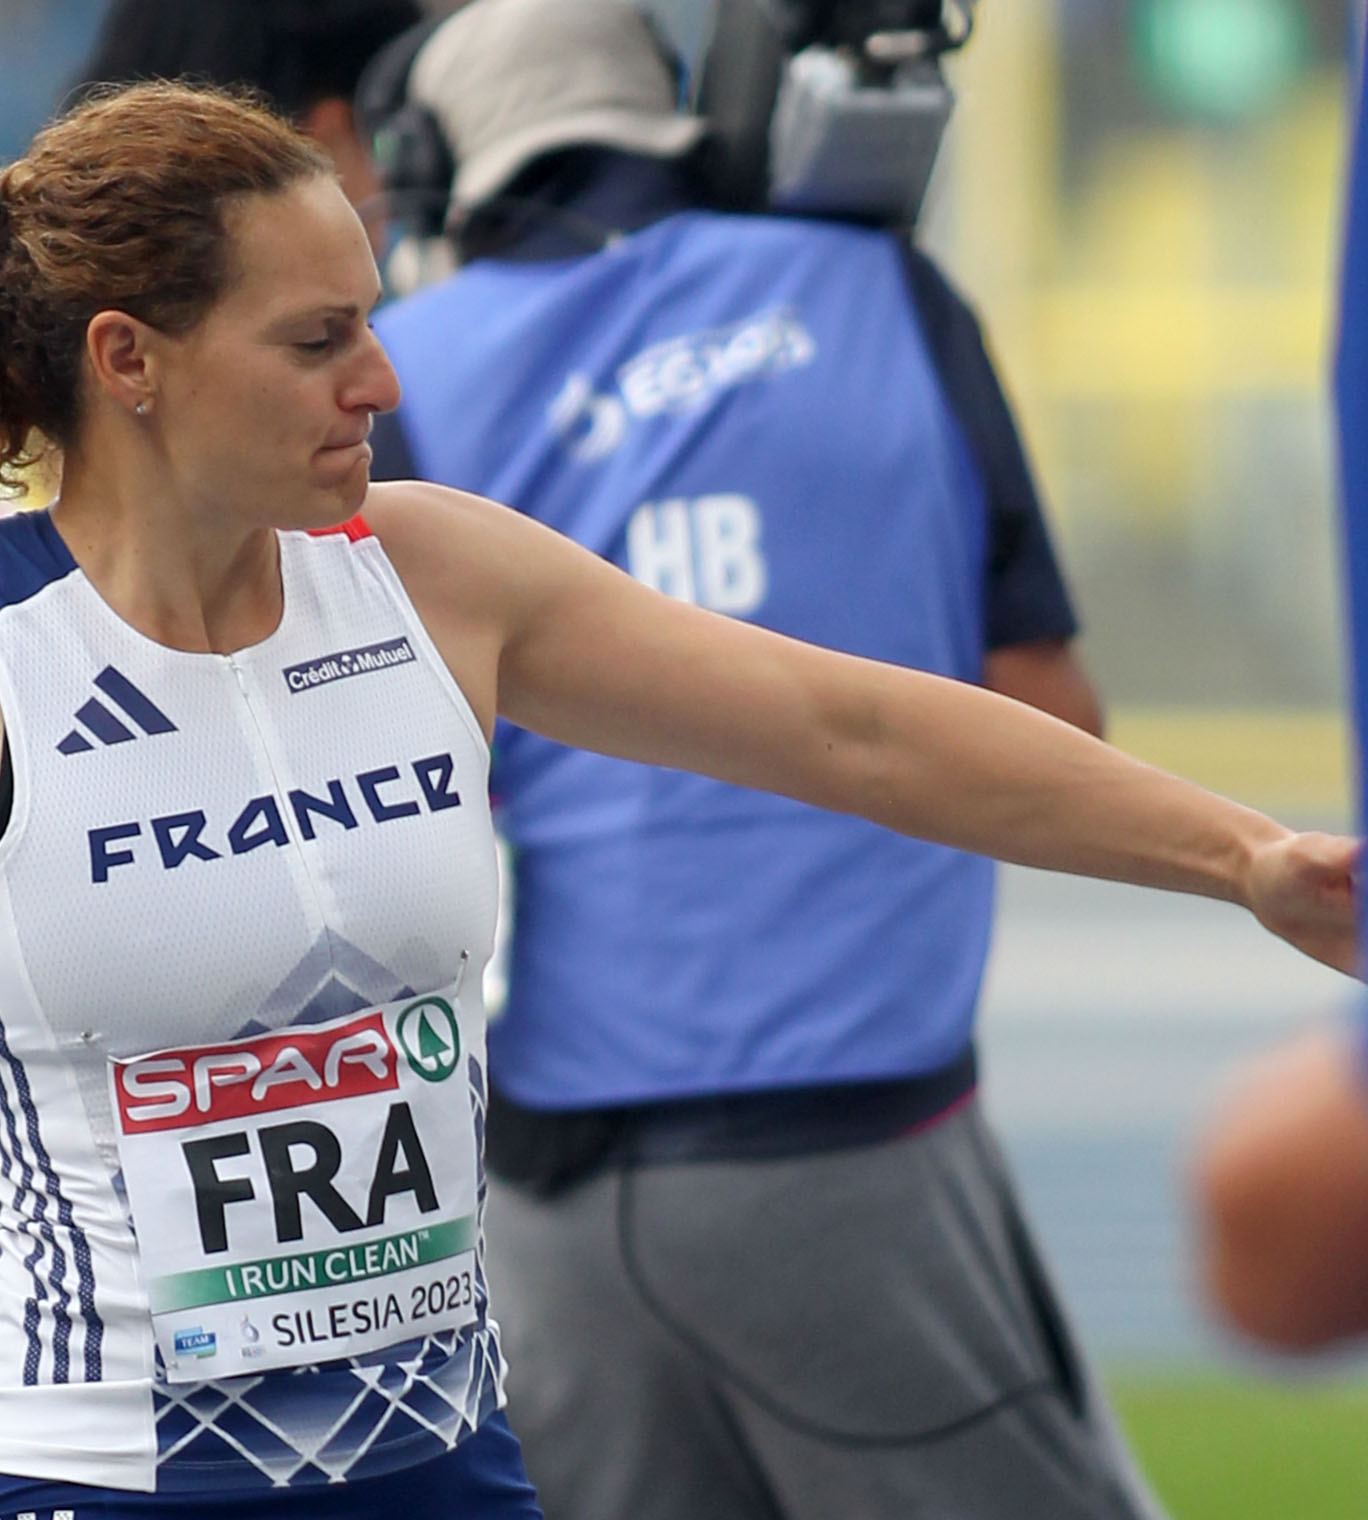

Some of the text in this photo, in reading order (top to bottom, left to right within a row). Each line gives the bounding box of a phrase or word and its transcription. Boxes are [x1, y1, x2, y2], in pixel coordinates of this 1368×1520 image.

[627, 494, 768, 615] HB
[288, 641, 413, 690] Crédit Mutuel
[88, 752, 462, 883] FRANCE
[121, 1028, 389, 1121] SPAR
[182, 1101, 440, 1254] FRA
[226, 1269, 237, 1297] I
[240, 1257, 317, 1294] RUN
[272, 1271, 473, 1347] SILESIA 2023
[181, 1334, 210, 1349] TEAM
